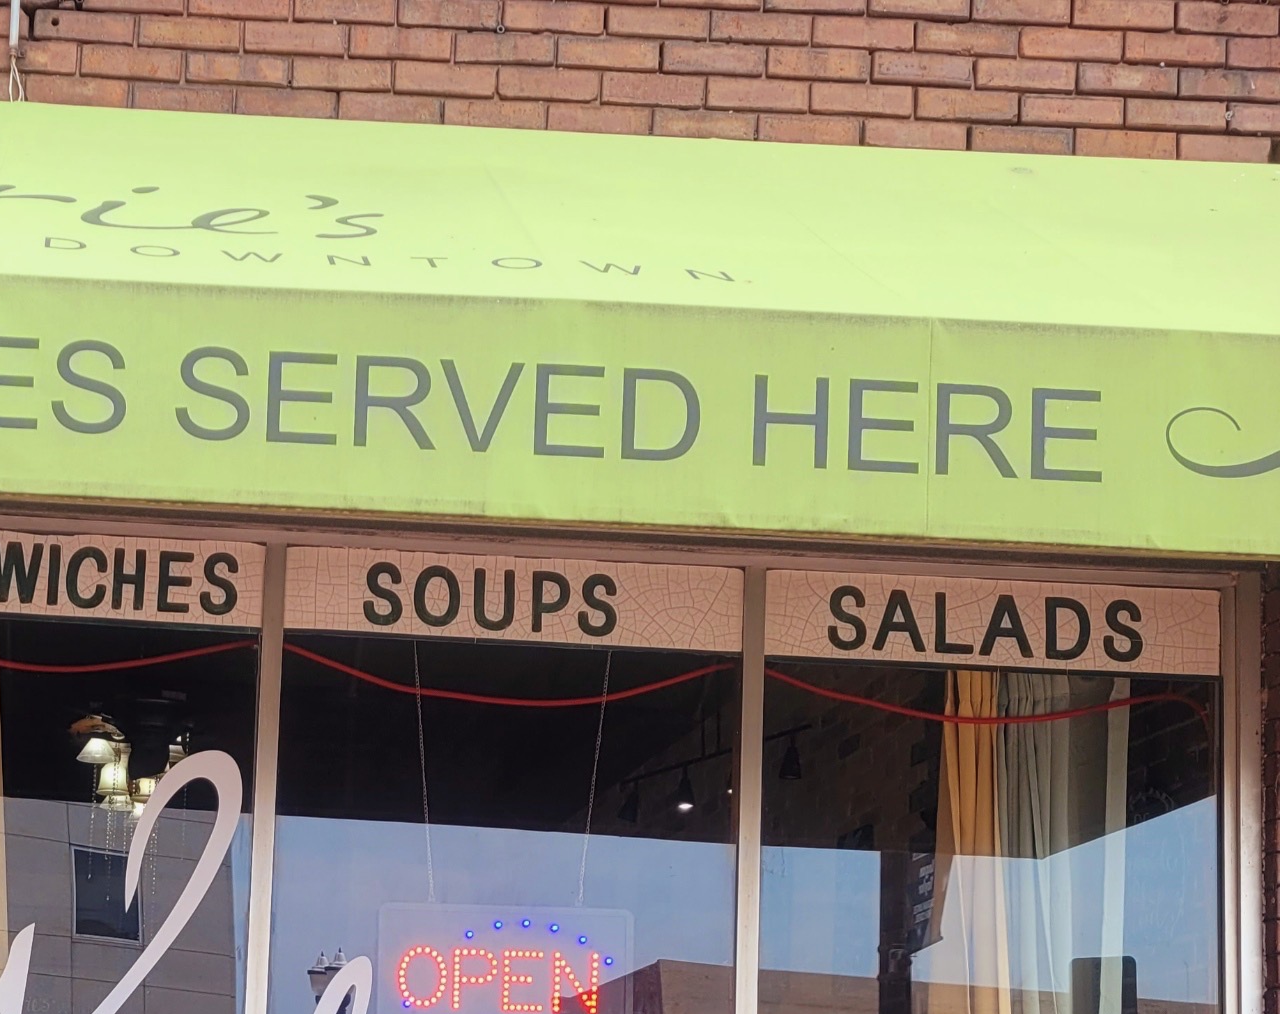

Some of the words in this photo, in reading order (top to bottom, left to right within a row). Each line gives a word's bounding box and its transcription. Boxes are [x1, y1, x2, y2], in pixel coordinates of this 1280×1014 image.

[44, 236, 736, 283] DOWNTOWN
[175, 346, 701, 461] SERVED
[752, 374, 1103, 482] HERE
[364, 561, 618, 638] SOUPS
[828, 585, 1144, 662] SALADS
